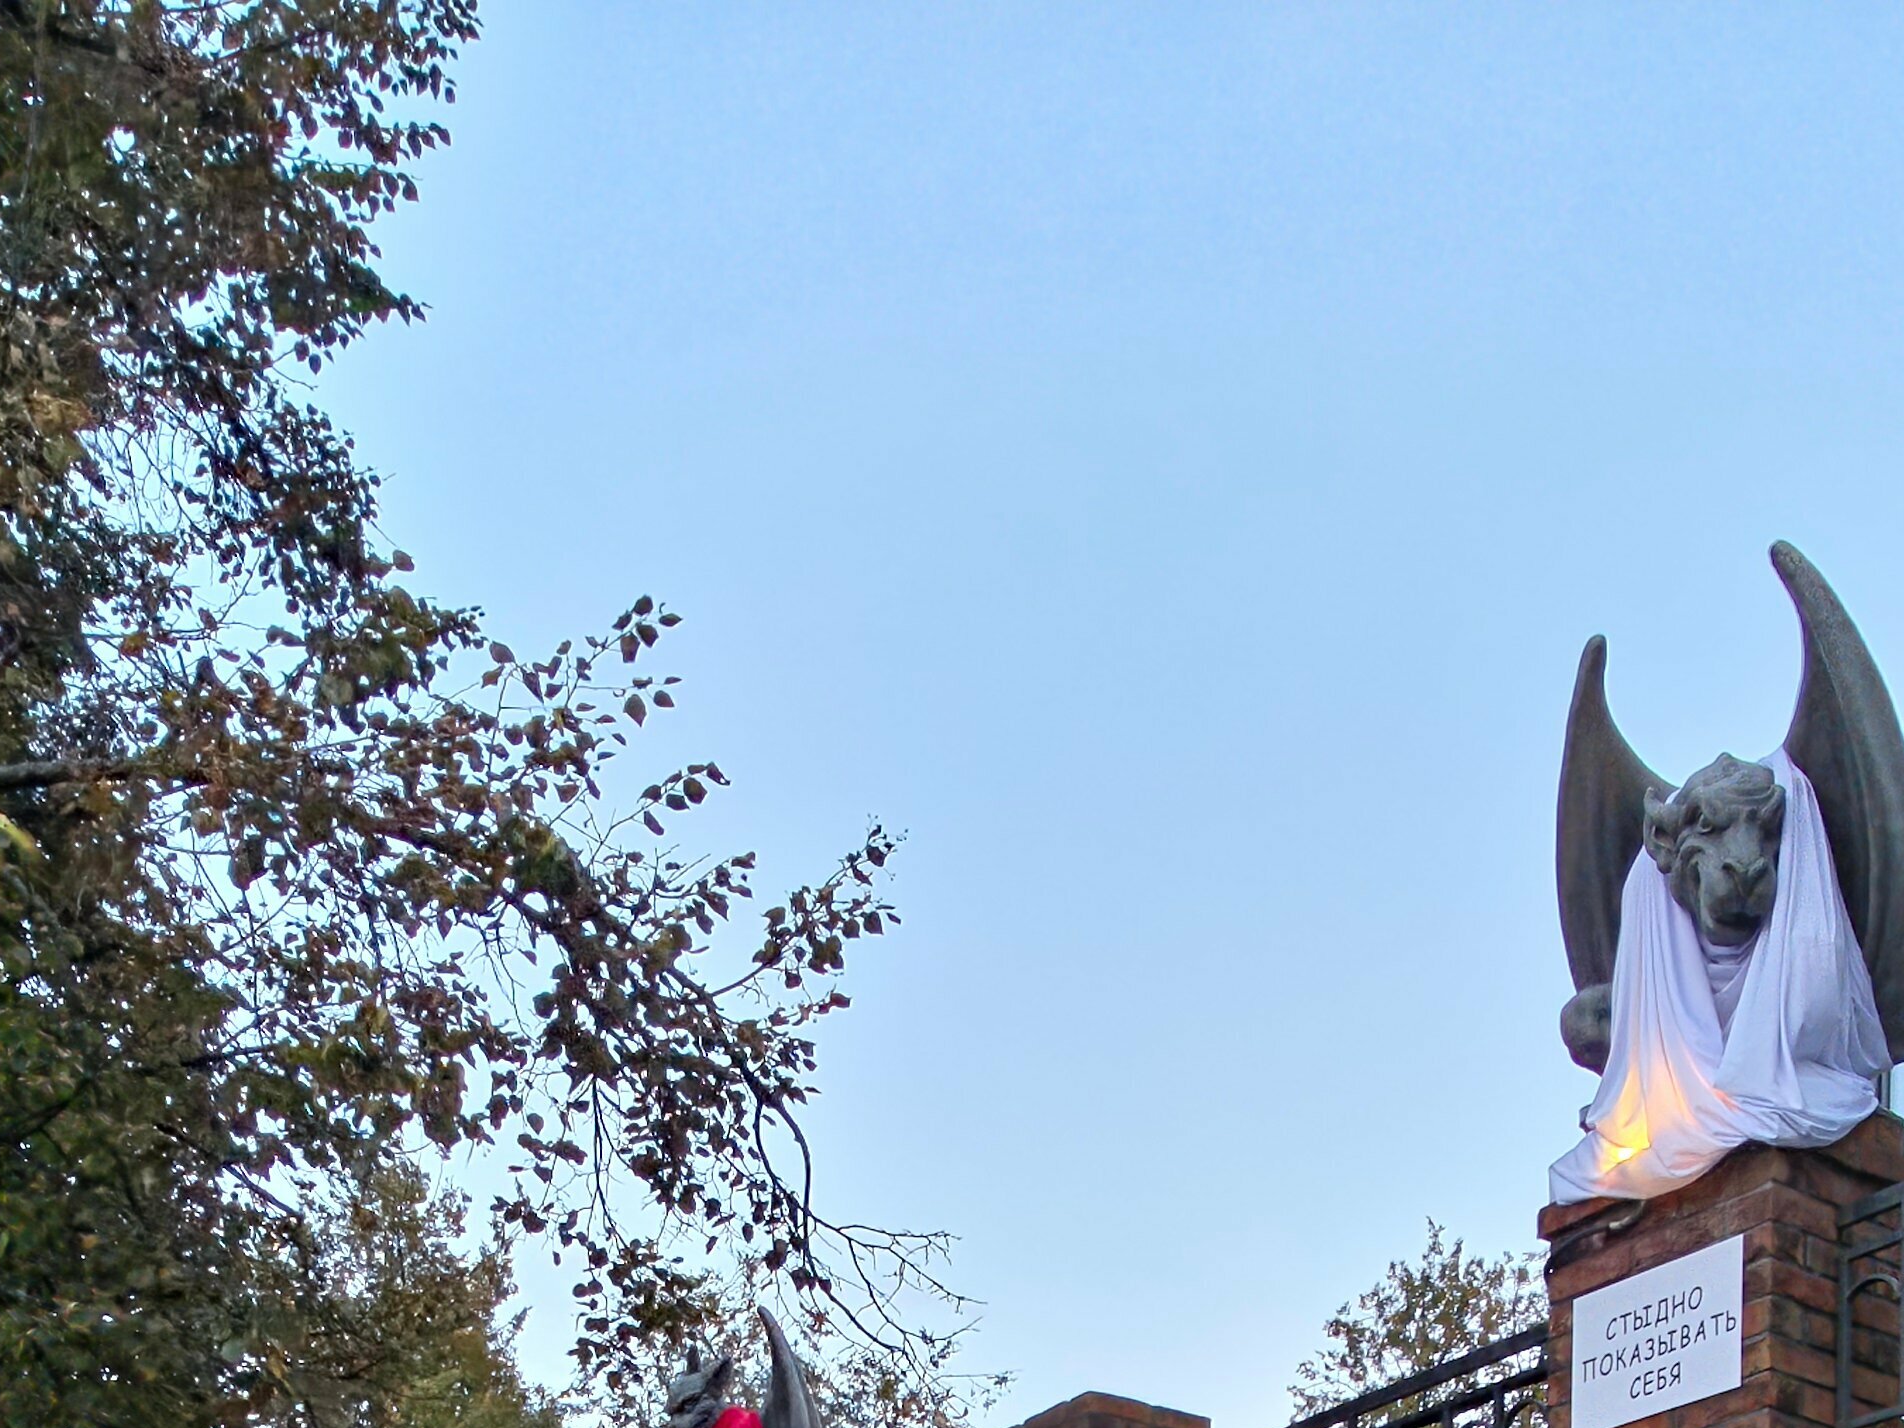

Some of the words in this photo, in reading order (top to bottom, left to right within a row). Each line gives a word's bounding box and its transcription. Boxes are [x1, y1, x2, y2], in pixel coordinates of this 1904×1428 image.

[1606, 1286, 1703, 1341] СТЫДНО
[1582, 1310, 1737, 1383] ПОКАЗЫВАТЬ
[1630, 1361, 1682, 1399] СЕБЯ
